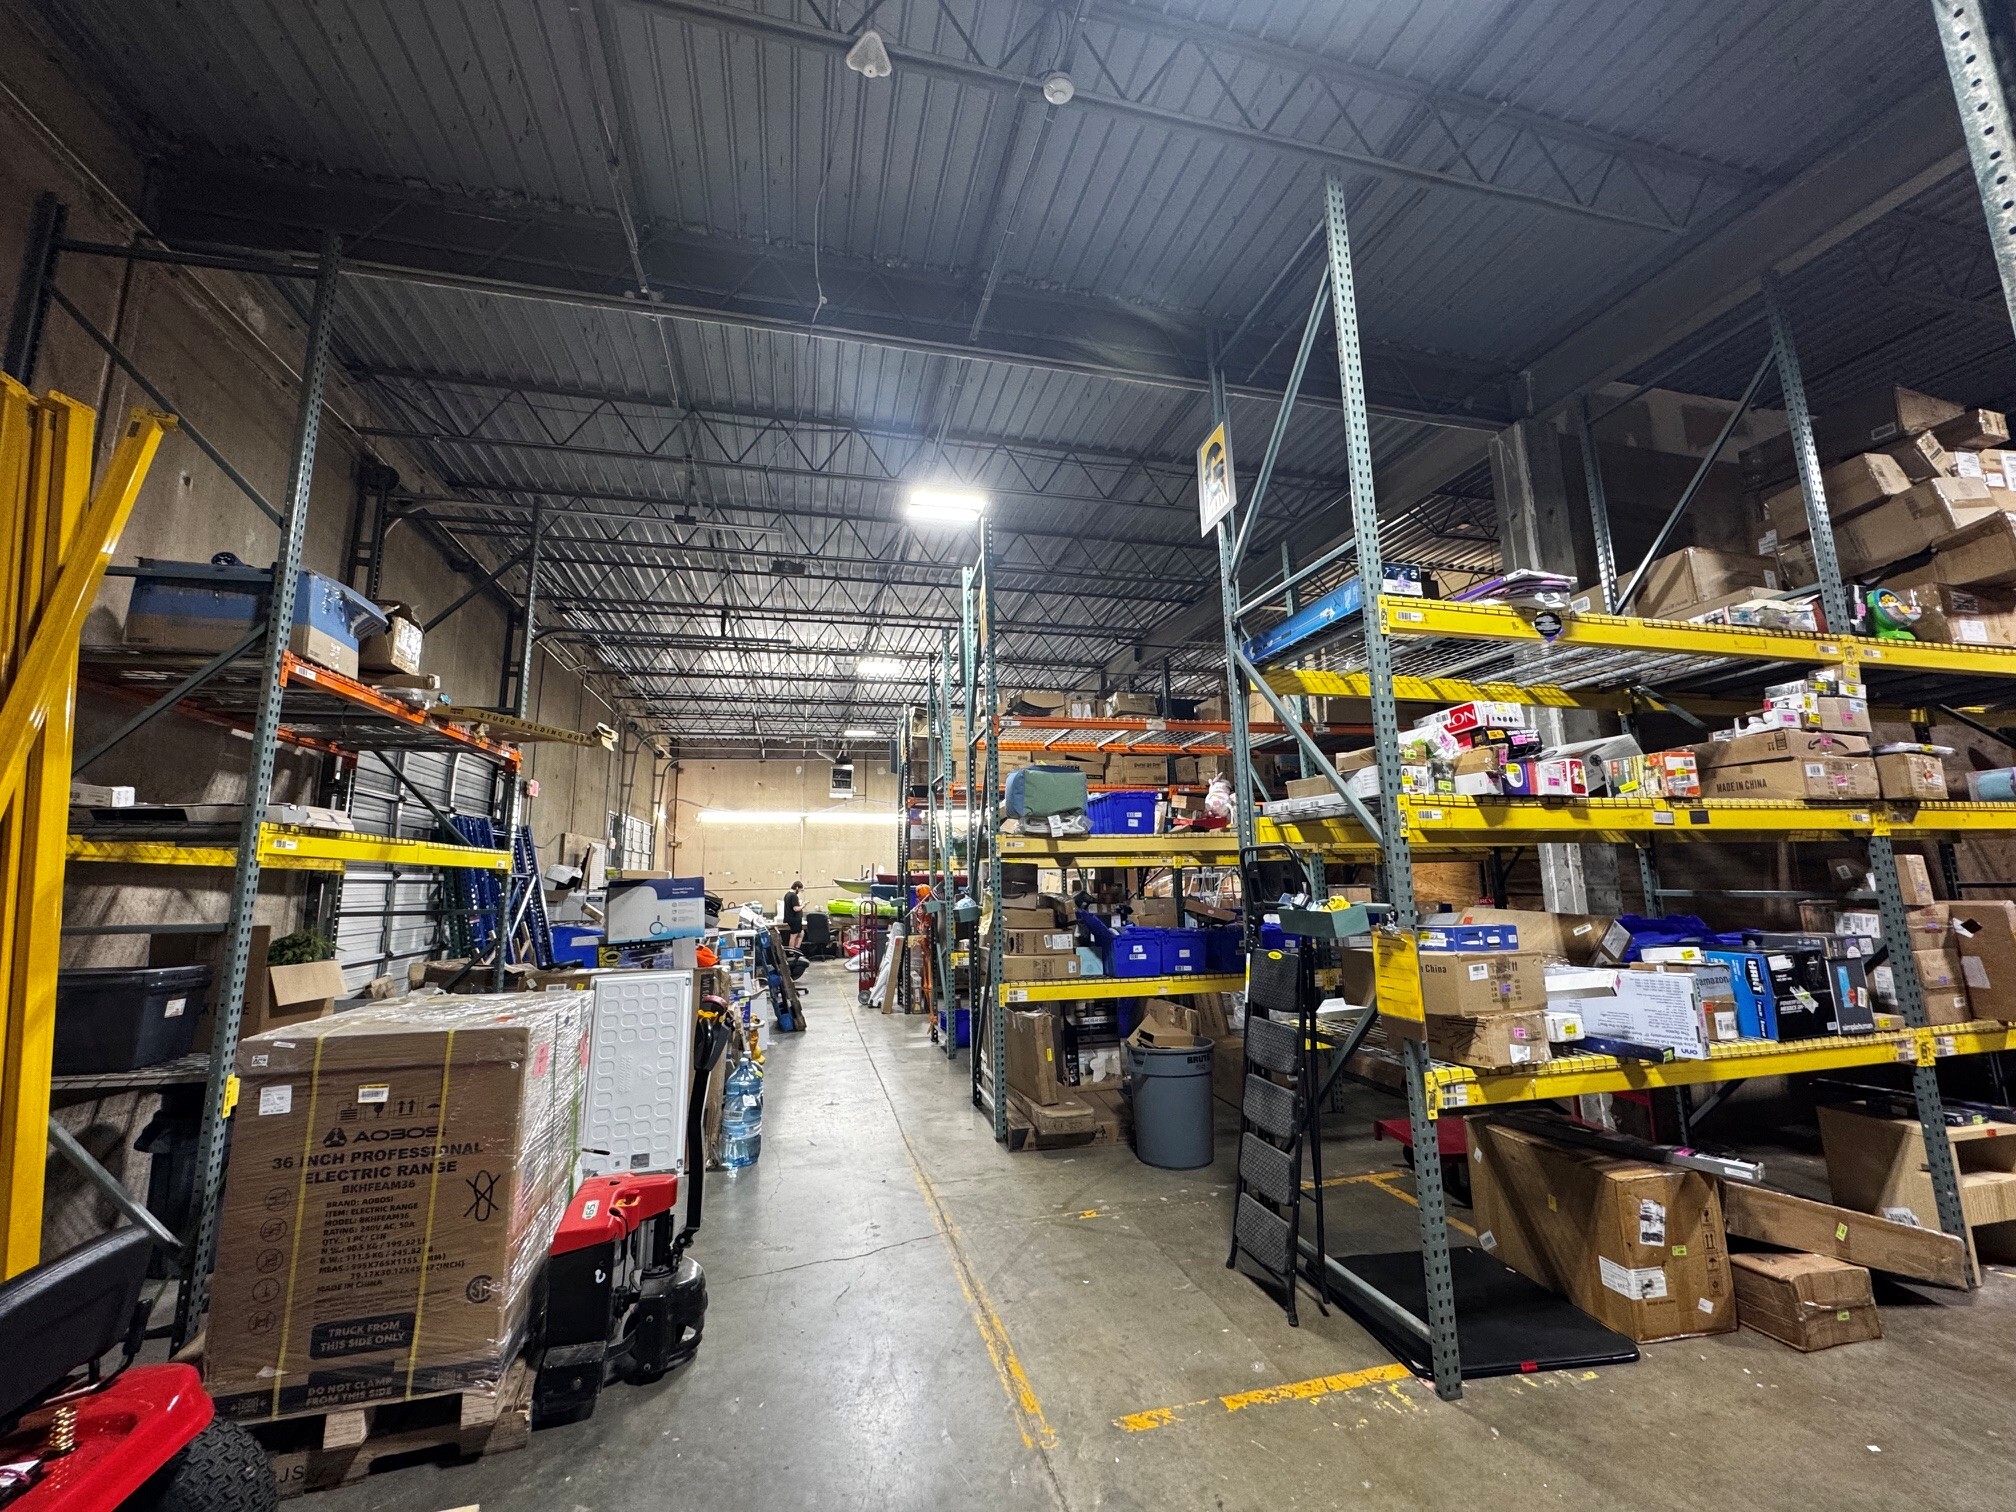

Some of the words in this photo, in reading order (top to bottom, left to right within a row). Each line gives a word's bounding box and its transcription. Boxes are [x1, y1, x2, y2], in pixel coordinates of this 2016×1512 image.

[480, 712, 516, 726] STUDIO
[521, 722, 562, 737] FOLDING
[1716, 782, 1735, 793] MADE
[1736, 781, 1744, 791] IN
[1745, 779, 1768, 790] CHINA
[1425, 964, 1447, 974] China
[1700, 975, 1730, 986] amazon
[1681, 1048, 1698, 1056] onn
[272, 1156, 294, 1169] 36
[300, 1153, 345, 1168] INCH
[350, 1142, 484, 1164] PROFESSIONAL
[305, 1166, 391, 1185] ELECTRIC
[397, 1160, 458, 1176] RANGE
[341, 1179, 416, 1194] BKHFEAM36
[325, 1209, 348, 1218] ITEM:
[351, 1206, 388, 1216] ELECTRIC
[389, 1202, 418, 1212] RANGE
[326, 1199, 360, 1209] BRAND:
[362, 1196, 394, 1205] AOBOSI
[324, 1218, 357, 1227] MODEL:
[323, 1227, 358, 1236] RATING:
[316, 1282, 343, 1293] MADE
[328, 1325, 364, 1338] TRUCK
[367, 1320, 400, 1332] FROM
[320, 1340, 346, 1352] THIS
[349, 1336, 373, 1348] SIDE
[375, 1331, 406, 1344] ONLY
[307, 1386, 325, 1397] DO
[327, 1382, 350, 1393] NOT
[354, 1377, 393, 1389] CLAMP
[305, 1394, 339, 1407] FROM
[341, 1391, 366, 1401] THIS
[368, 1387, 393, 1398] SIDE
